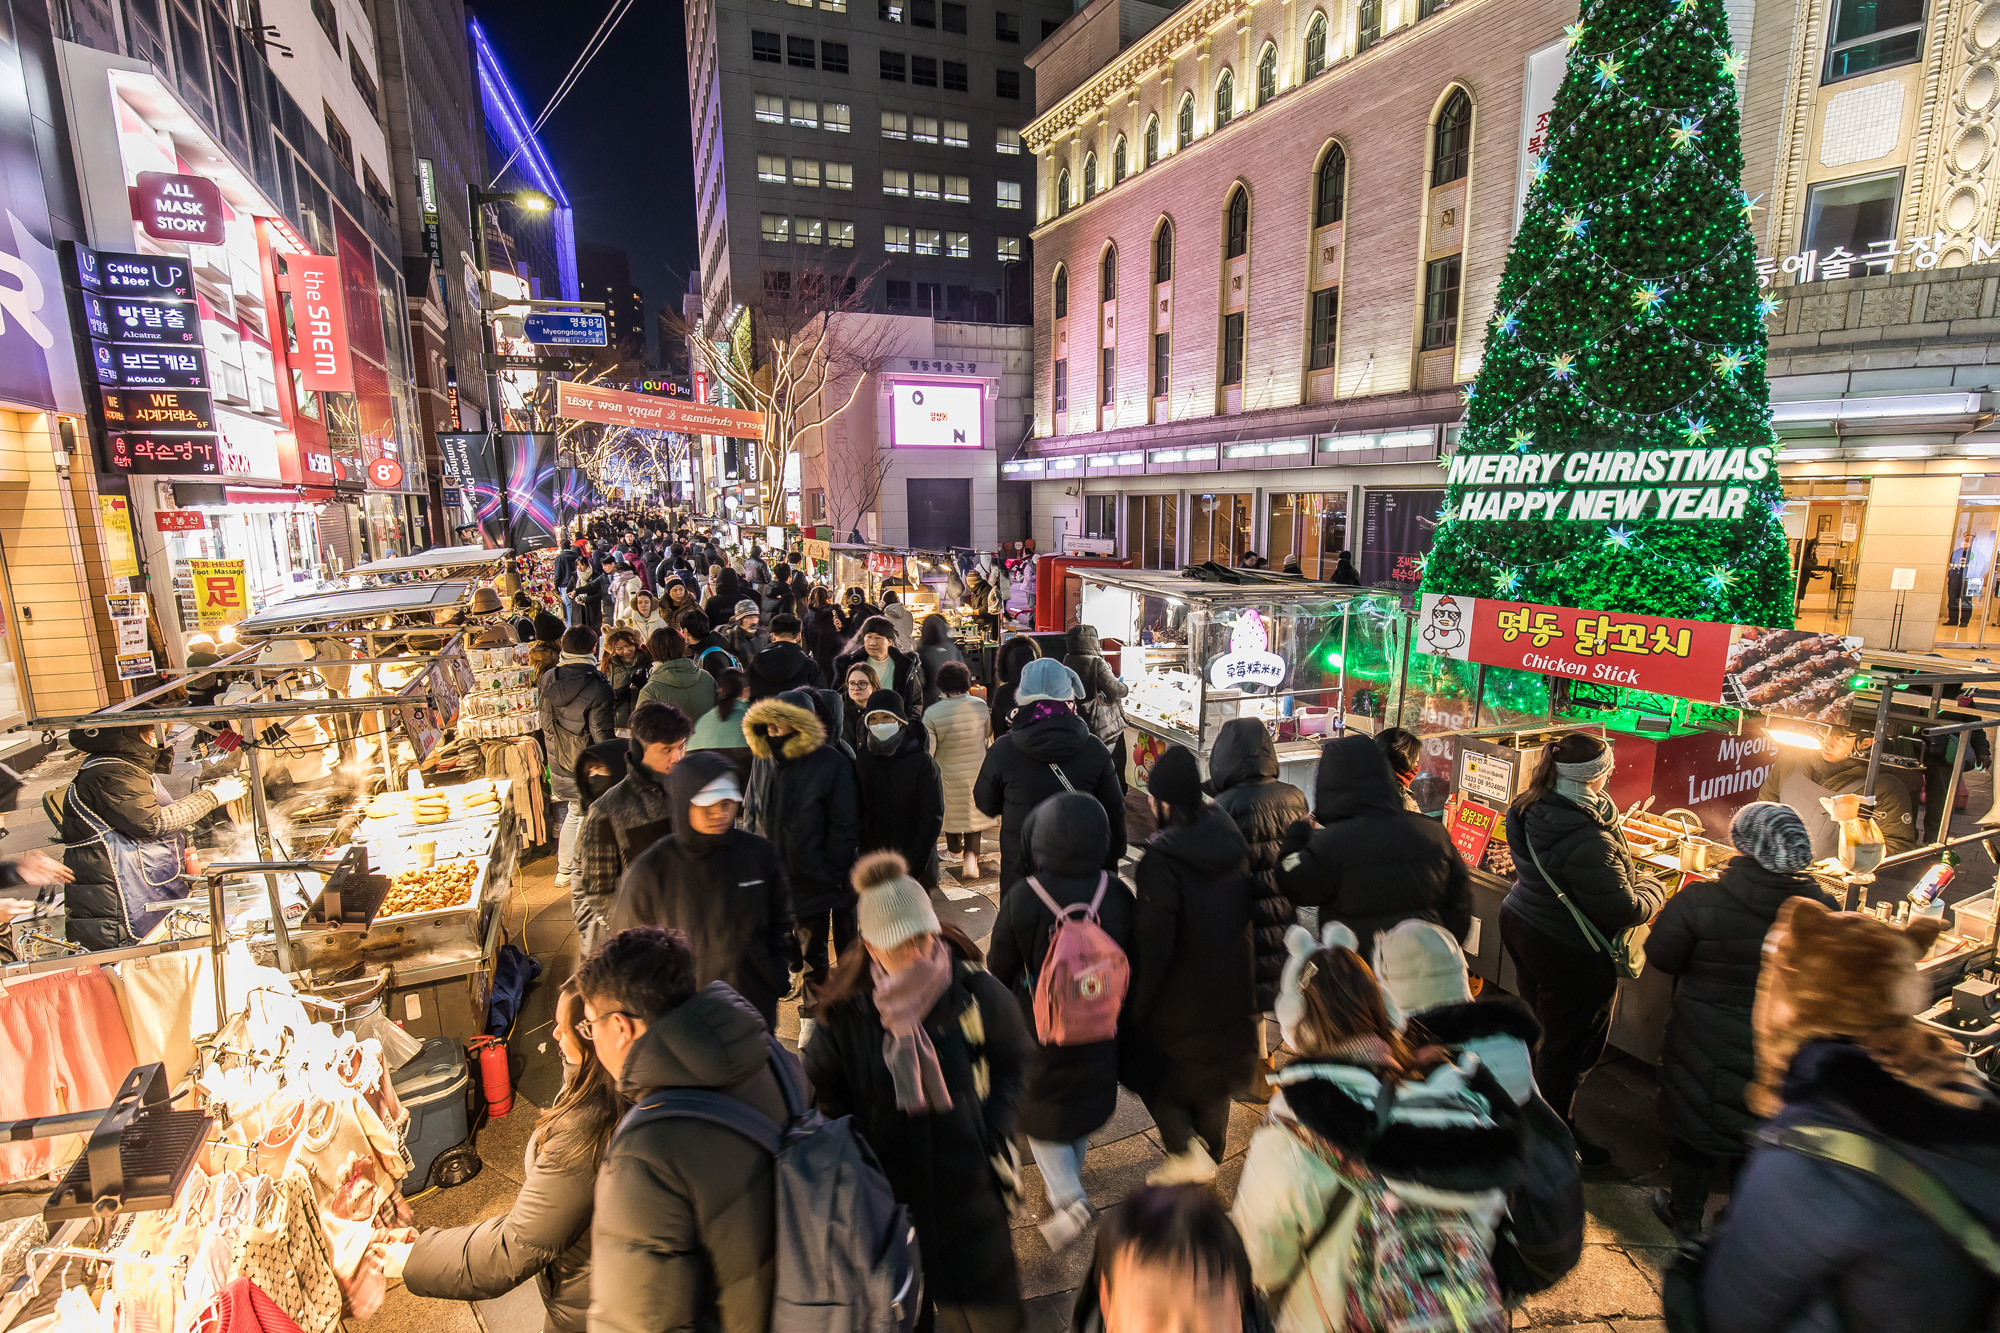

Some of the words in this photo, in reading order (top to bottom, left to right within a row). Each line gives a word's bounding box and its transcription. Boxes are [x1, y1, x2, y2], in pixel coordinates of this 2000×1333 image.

[163, 183, 194, 198] ALL
[156, 199, 204, 216] MASK
[157, 216, 207, 232] STORY
[1754, 232, 1949, 288] 동예술극장
[108, 263, 148, 274] Coffee
[110, 275, 120, 286] &
[122, 276, 150, 287] Beer
[304, 272, 324, 300] the
[175, 288, 186, 296] 9F
[118, 306, 186, 328] 방탈출
[570, 318, 602, 328] 명동8길
[122, 331, 162, 339] Alcatraz
[182, 333, 194, 341] 8F
[308, 305, 337, 375] SAEM
[542, 328, 586, 336] Myeongdong
[122, 353, 198, 371] 보드게임
[909, 360, 976, 373] 명동예술극장
[126, 376, 166, 384] MONACO
[190, 377, 200, 385] 7F
[634, 380, 676, 396] young
[107, 395, 118, 408] WE
[150, 394, 178, 407] WE
[136, 409, 198, 422] 시계거래소
[134, 440, 212, 461] 약손명가
[456, 438, 472, 477] Myeong
[203, 463, 215, 471] 5F
[444, 438, 462, 486] Luminous
[1447, 453, 1564, 484] MERRY
[1564, 446, 1773, 484] CHRISTMAS
[1458, 488, 1568, 521] HAPPY
[1567, 488, 1657, 520] NEW
[1655, 487, 1750, 520] YEAR
[162, 516, 199, 526] 부동산
[206, 577, 240, 608] 足
[1497, 606, 1564, 647] 명동
[1574, 614, 1693, 658] 닭꼬치
[1522, 652, 1588, 676] Chicken
[1592, 663, 1640, 685] Stick
[1478, 766, 1504, 780] kakaobank
[1688, 764, 1775, 805] Lumino
[1460, 807, 1491, 831] 왕닭꼬치
